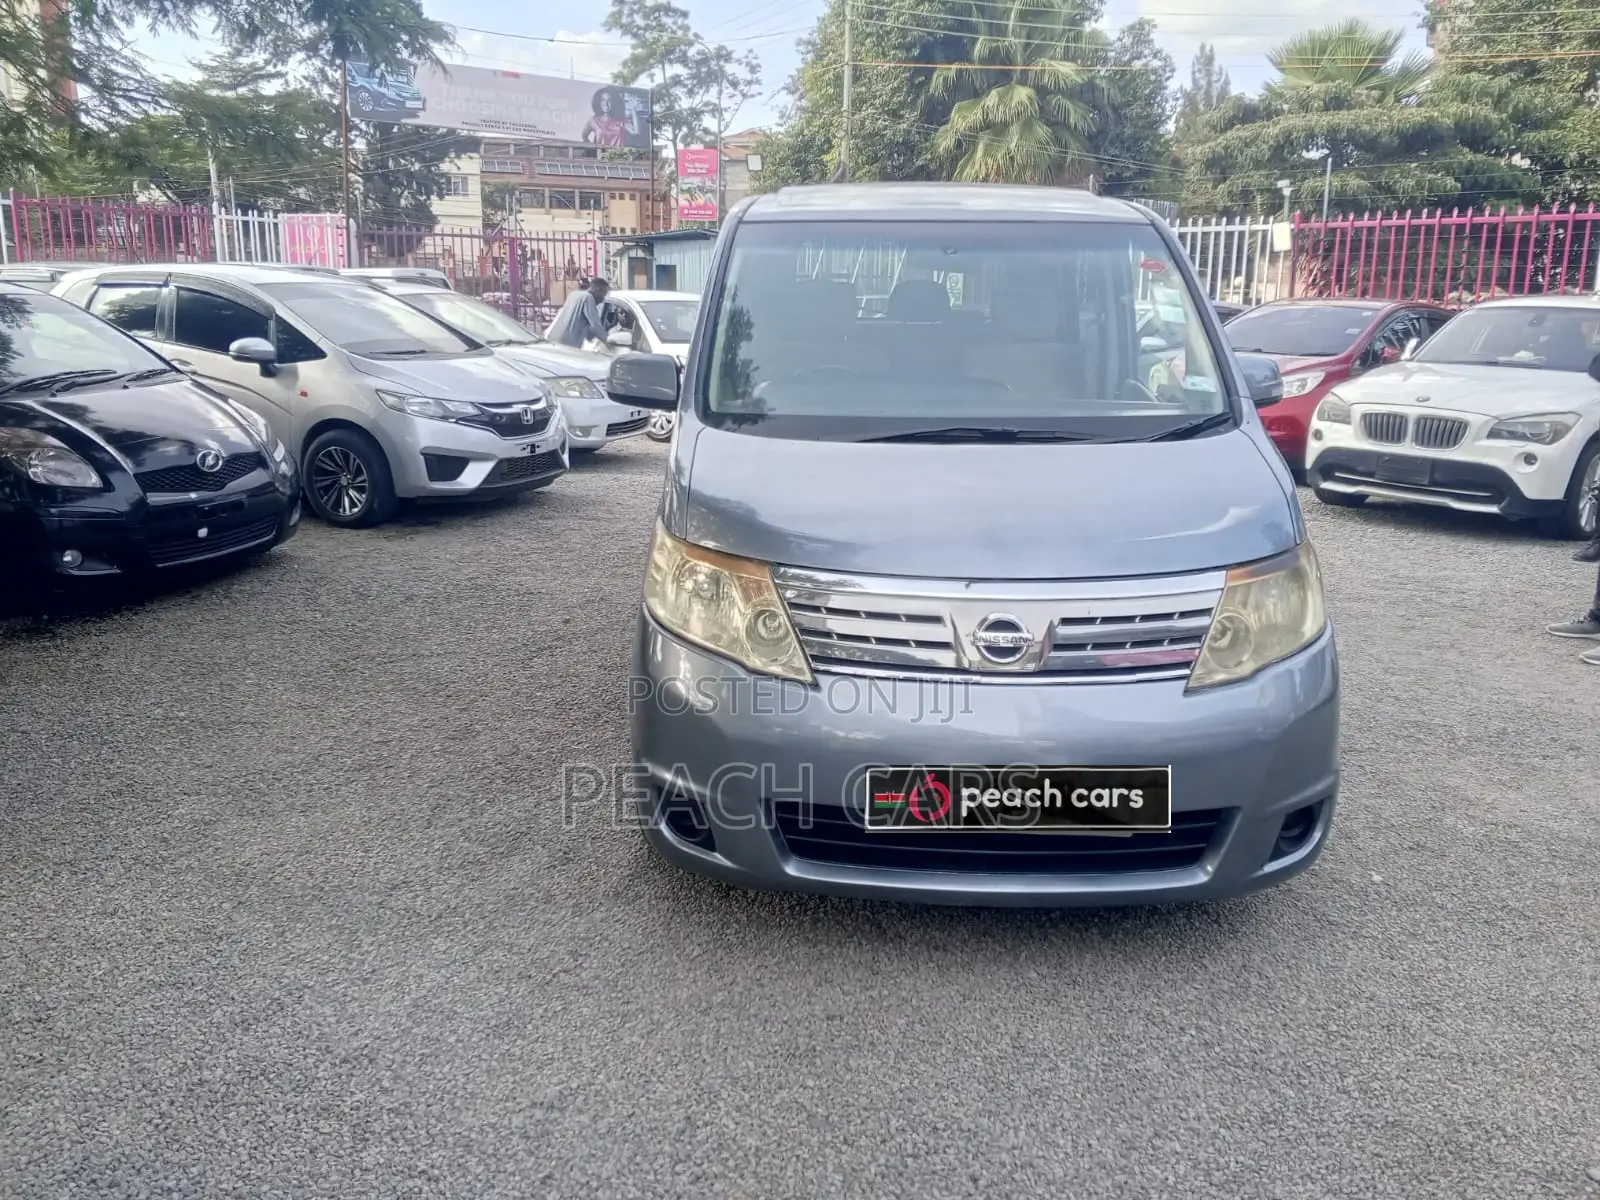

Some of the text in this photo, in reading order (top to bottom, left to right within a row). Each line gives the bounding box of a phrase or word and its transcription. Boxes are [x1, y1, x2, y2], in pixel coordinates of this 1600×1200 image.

[977, 635, 1028, 644] NISSAN
[961, 778, 1144, 818] peach cars
